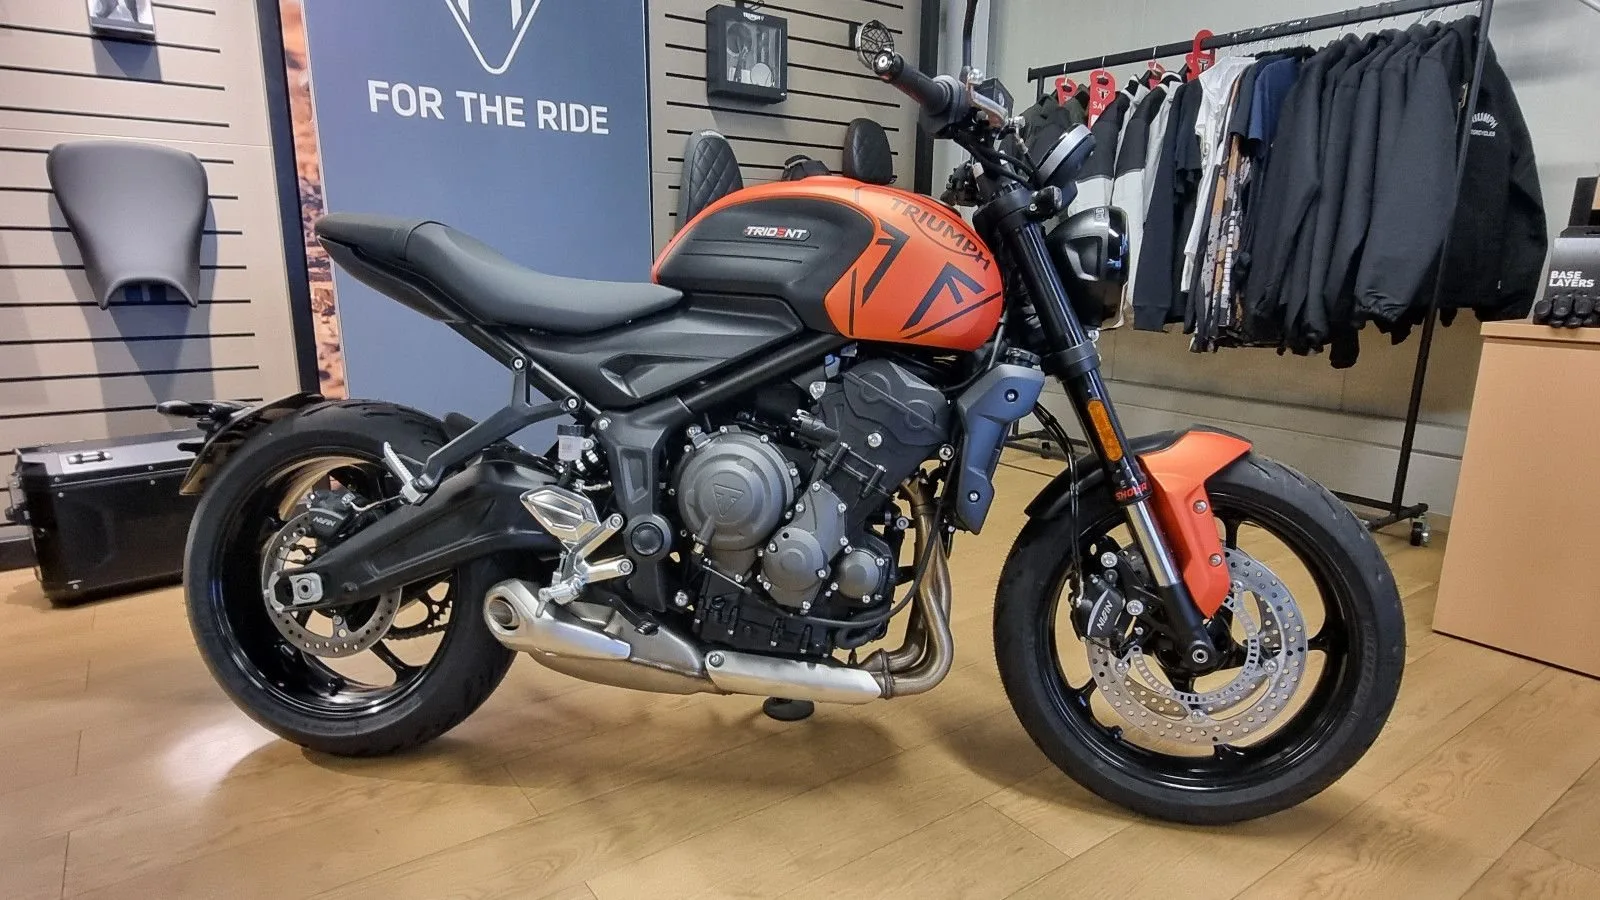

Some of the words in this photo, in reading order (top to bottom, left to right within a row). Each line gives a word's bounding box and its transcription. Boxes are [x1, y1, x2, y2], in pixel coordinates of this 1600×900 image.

[368, 79, 445, 120] FOR
[455, 90, 526, 127] THE
[537, 100, 609, 135] RIDE
[745, 226, 807, 239] TRIDENT
[889, 198, 991, 271] TRIUMPH
[1550, 270, 1583, 279] BASE
[1548, 279, 1595, 288] LAYERS
